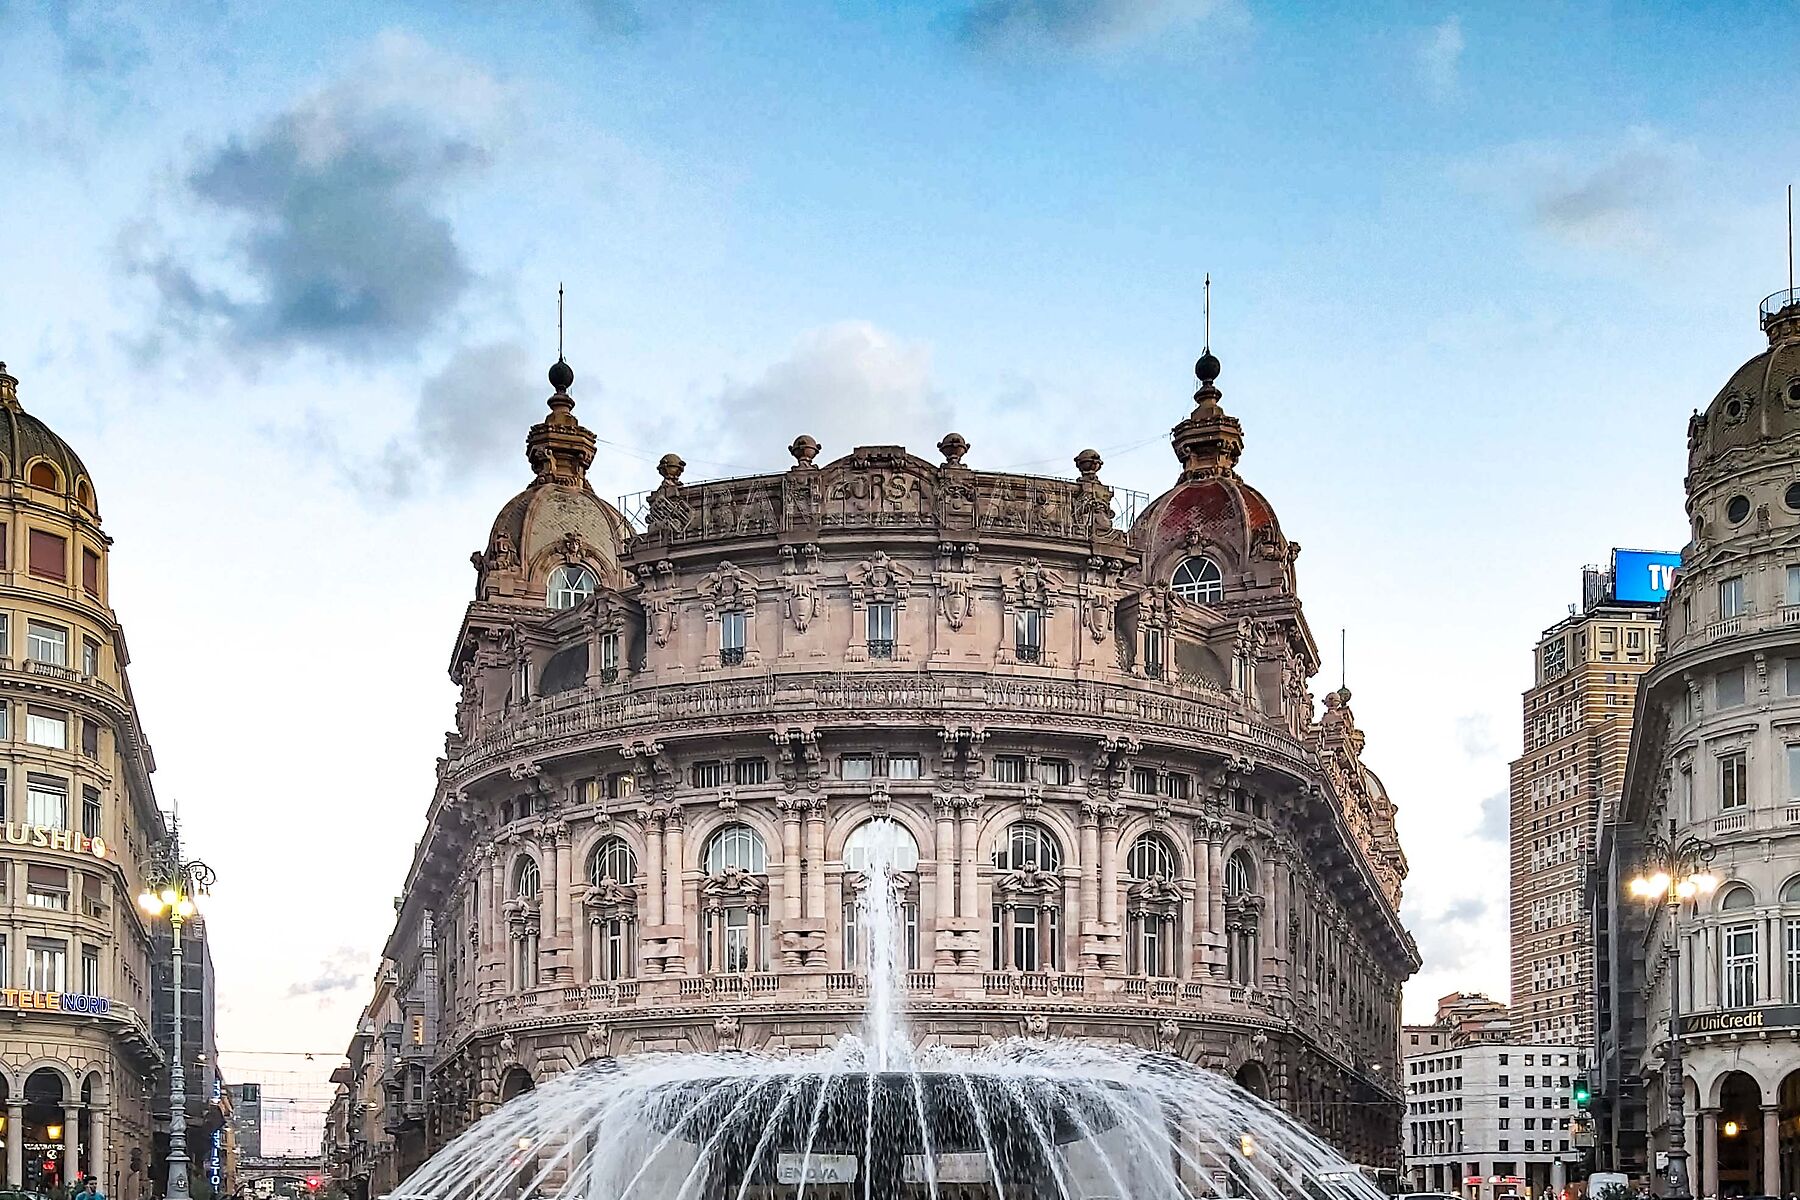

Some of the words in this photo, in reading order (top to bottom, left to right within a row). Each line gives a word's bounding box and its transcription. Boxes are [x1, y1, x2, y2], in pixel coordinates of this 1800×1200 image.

[0, 821, 81, 853] USHI
[2, 989, 60, 1009] TELE
[62, 992, 110, 1014] NORD
[1700, 1011, 1763, 1030] UniCredit
[780, 1166, 839, 1180] ENOVA
